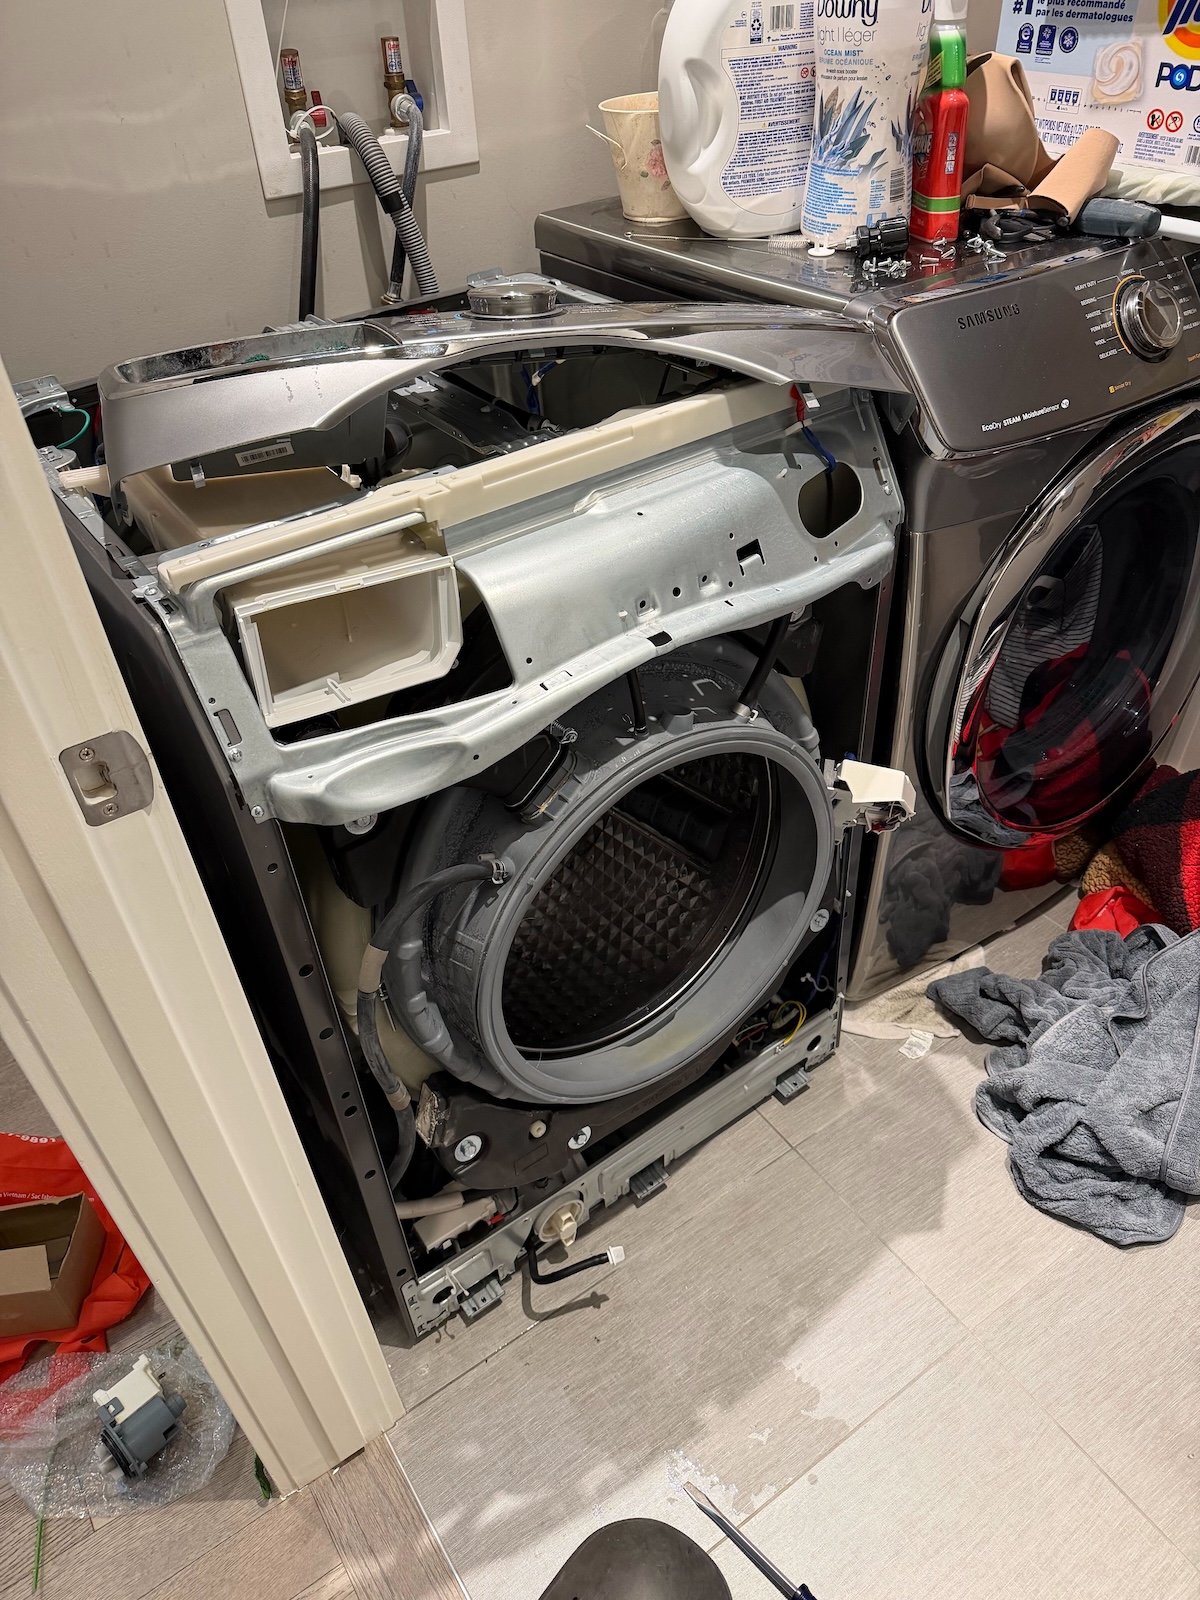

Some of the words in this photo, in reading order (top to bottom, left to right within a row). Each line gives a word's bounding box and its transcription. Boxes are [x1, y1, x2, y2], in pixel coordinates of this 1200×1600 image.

[1068, 0, 1126, 10] recommandé
[1035, 9, 1050, 17] par
[1052, 8, 1064, 18] les
[1066, 9, 1134, 23] dermatologues
[842, 27, 878, 47] léger
[824, 48, 842, 56] OCEAN
[835, 58, 874, 66] OCÉANIQUE
[767, 118, 801, 127] AVERTISSEMENT
[1074, 283, 1087, 292] HEAVY
[1086, 280, 1097, 288] DUTY
[1080, 297, 1097, 306] BEDDING
[957, 303, 1021, 330] SAMSUNG
[1099, 349, 1118, 360] DELICATES
[981, 418, 1002, 432] EcoDry
[1002, 415, 1021, 428] STEAM
[1022, 403, 1060, 421] MoistureSensor
